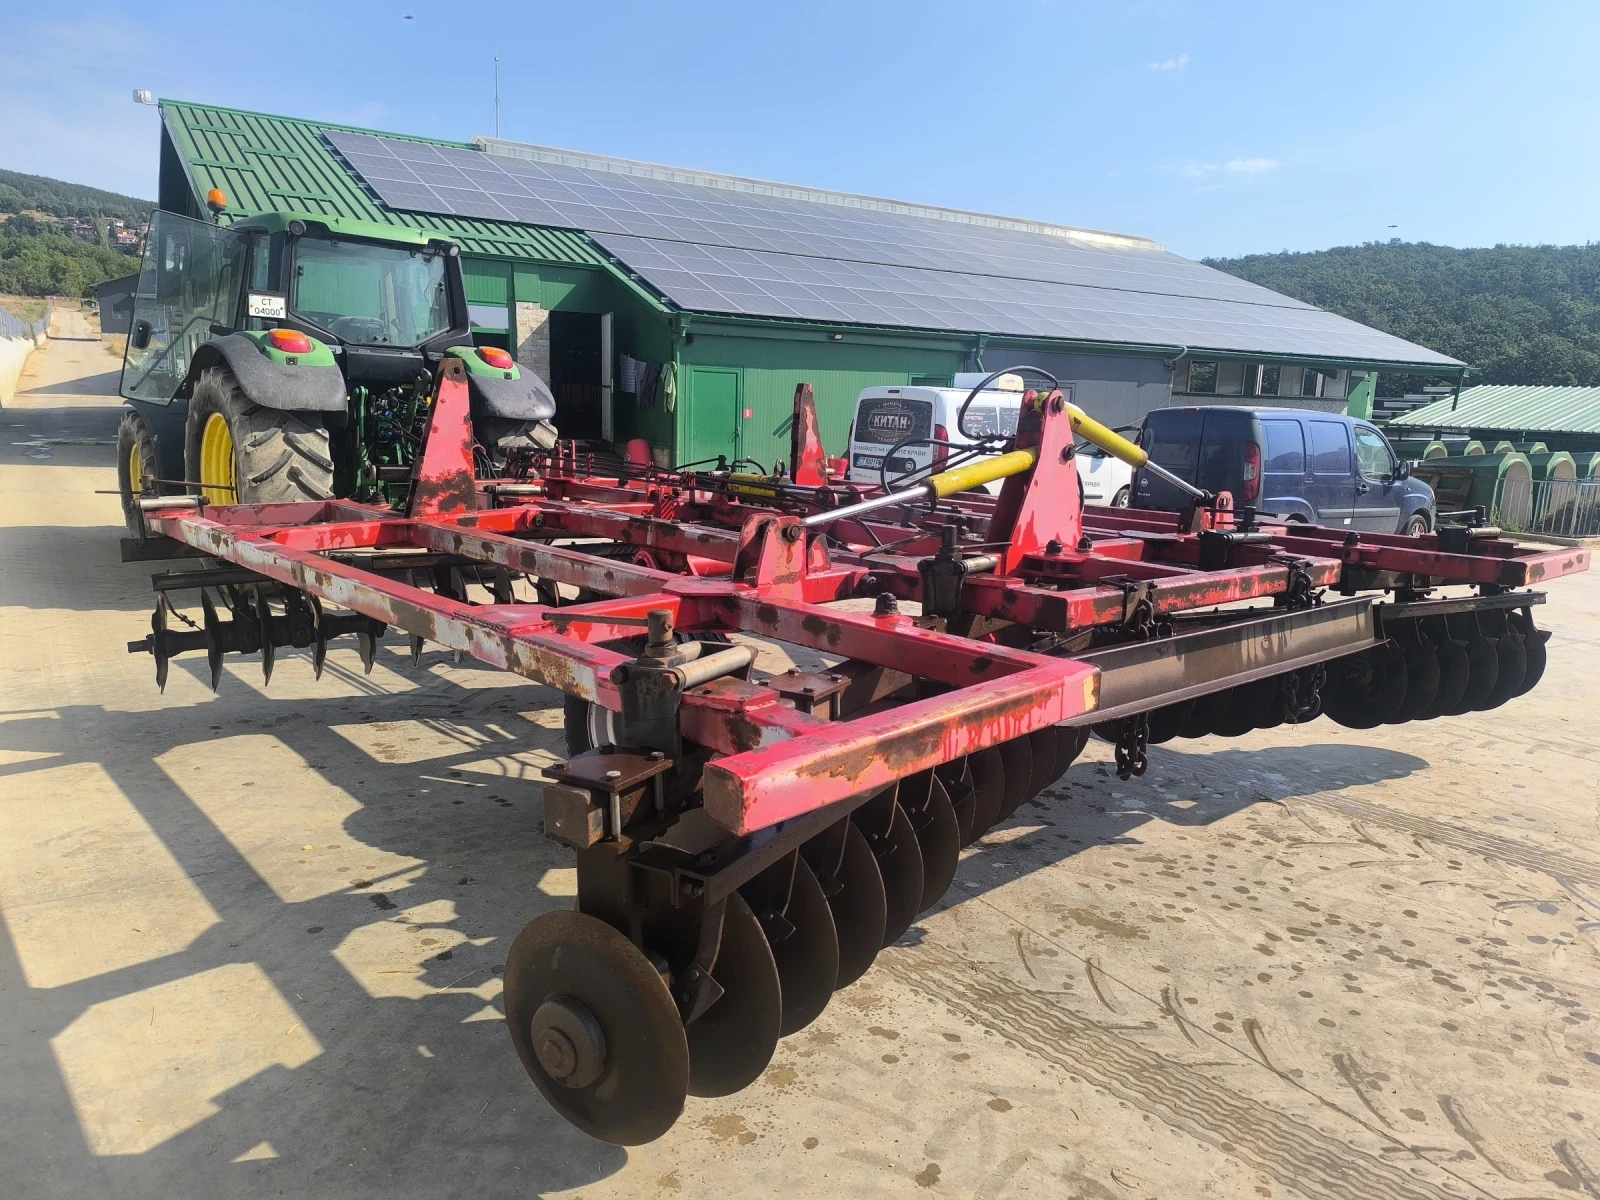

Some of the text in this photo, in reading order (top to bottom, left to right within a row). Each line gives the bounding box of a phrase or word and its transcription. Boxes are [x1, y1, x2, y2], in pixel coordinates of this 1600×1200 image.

[261, 298, 273, 306] CT
[254, 306, 281, 316] 04000
[874, 415, 908, 429] КИТАН
